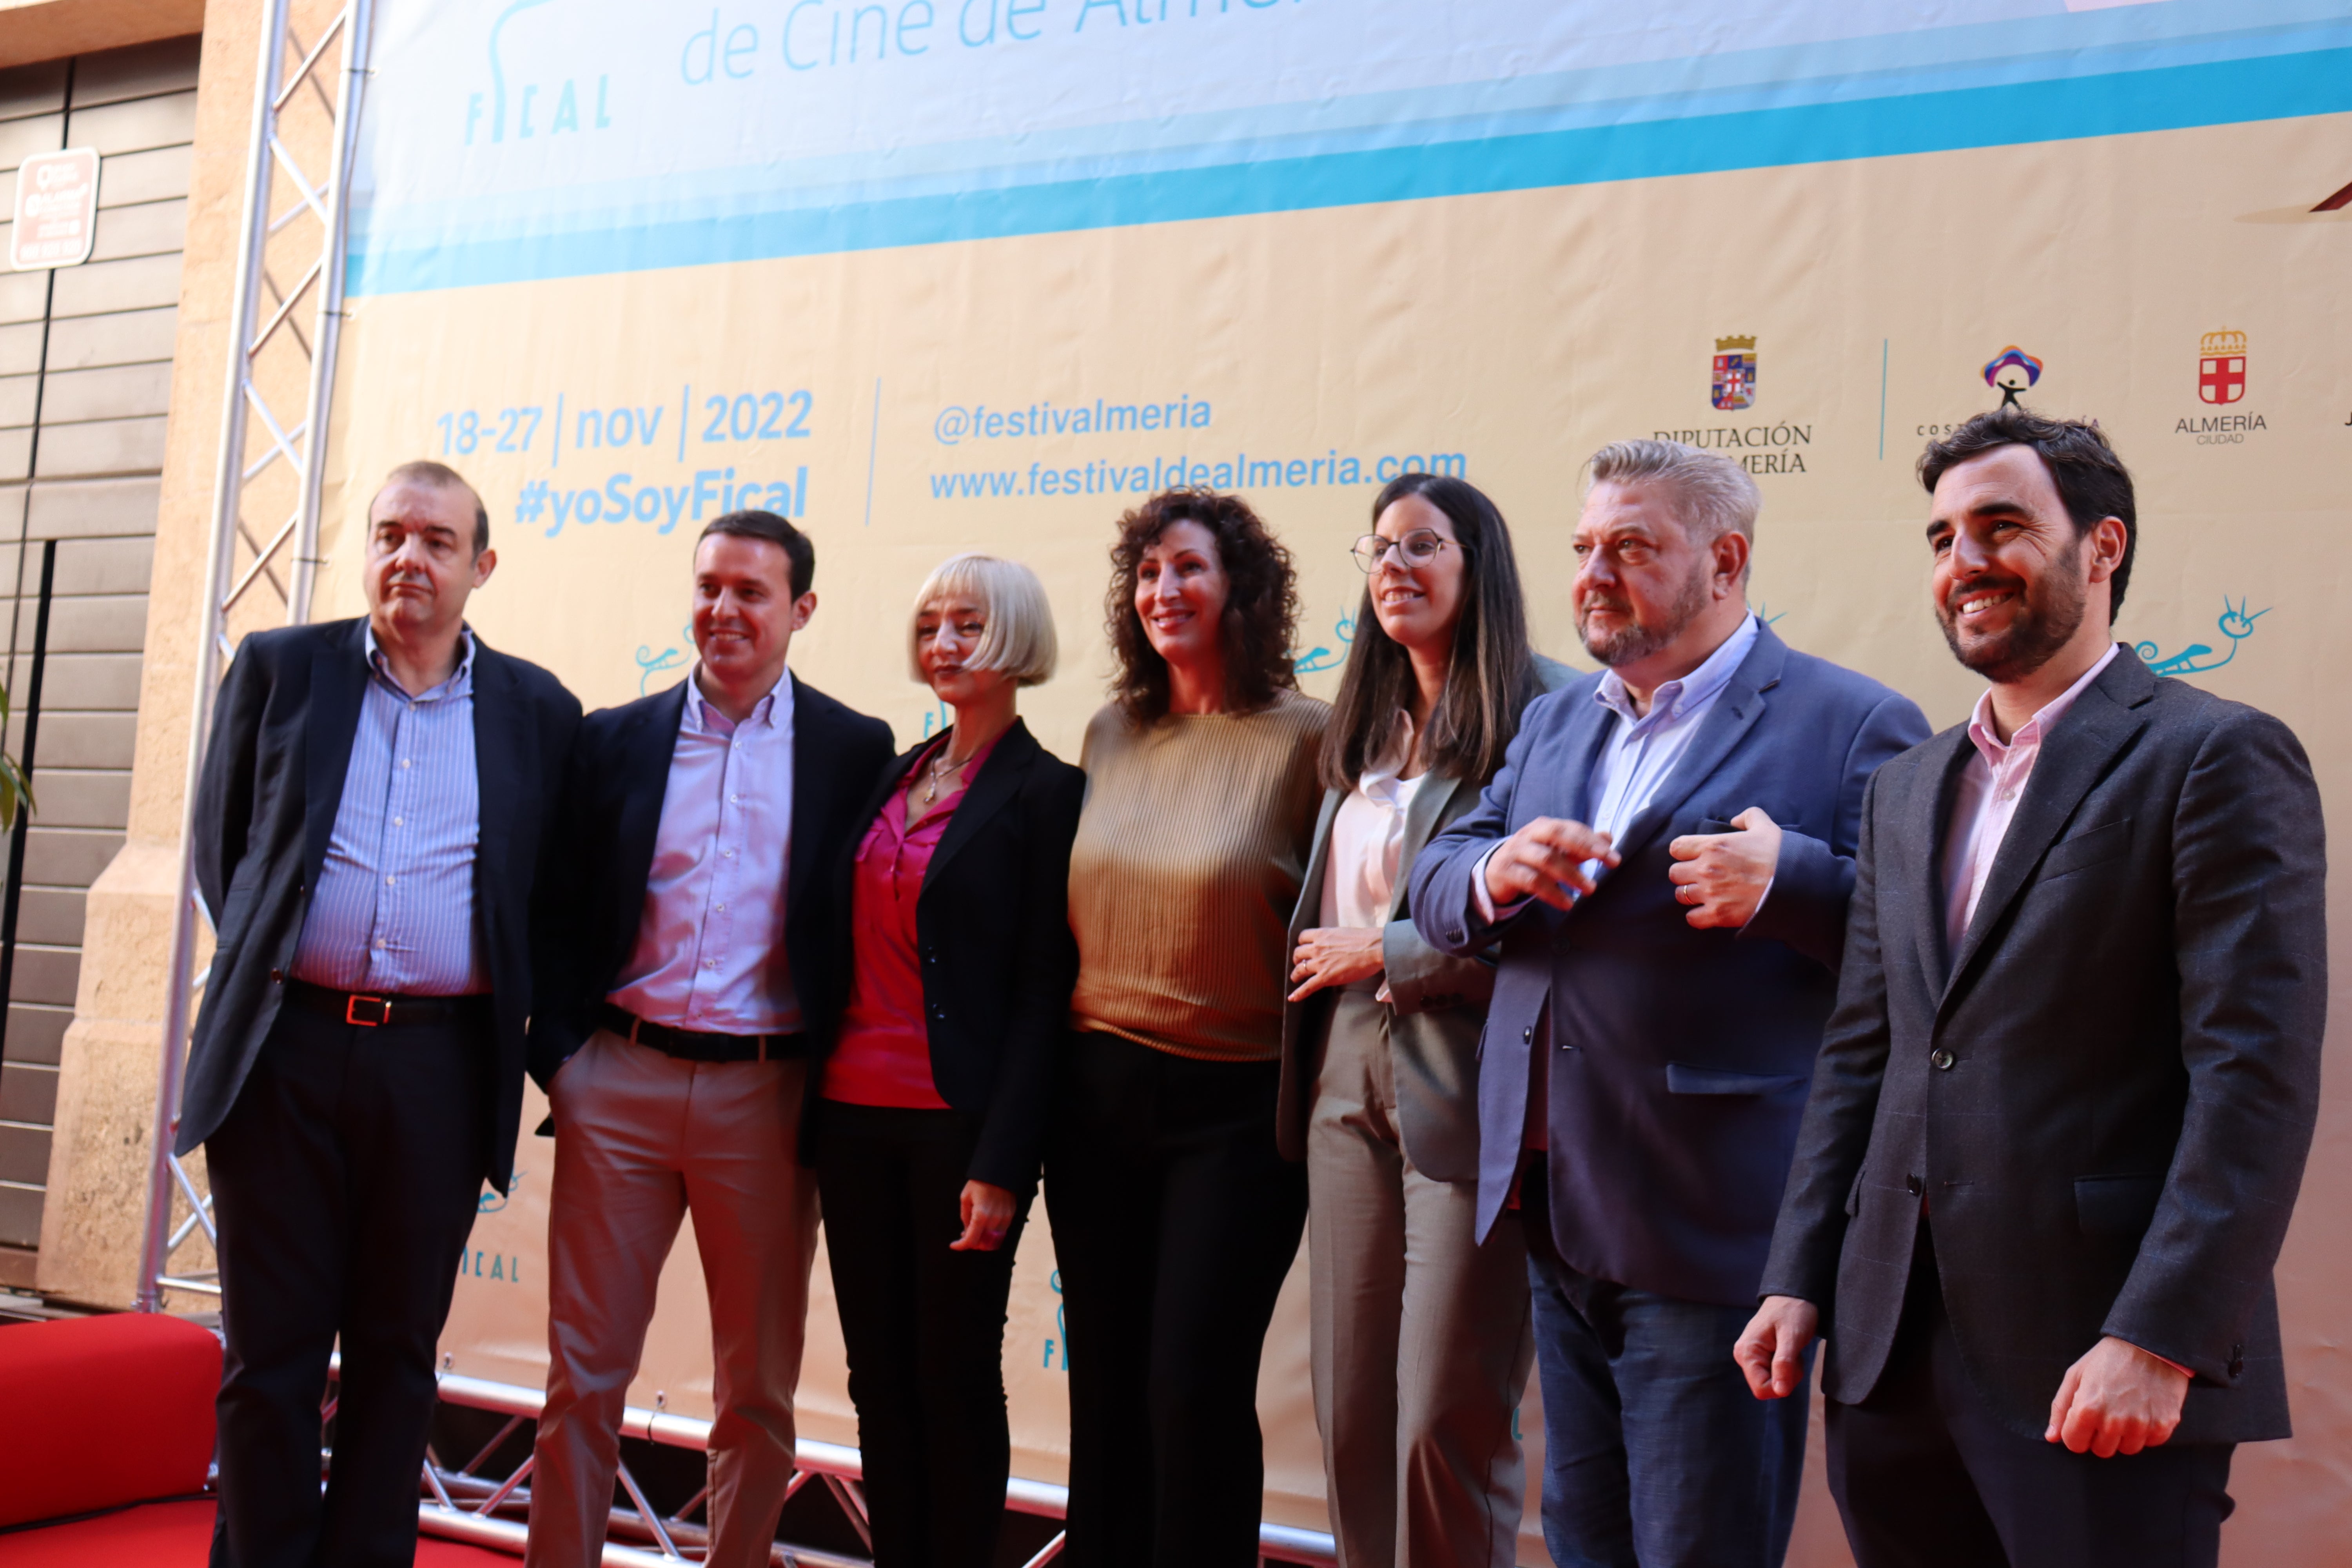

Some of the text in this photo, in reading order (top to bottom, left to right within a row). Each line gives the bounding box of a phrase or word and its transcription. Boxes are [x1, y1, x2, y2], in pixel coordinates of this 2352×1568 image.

[682, 7, 759, 85] de
[783, 0, 934, 71] Cine
[437, 390, 813, 456] 18-27 nov 2022
[935, 394, 1212, 445] @festivalmeria
[2175, 412, 2267, 433] ALMERÍA
[2196, 434, 2244, 445] CIUDAD
[930, 449, 1467, 499] www.festivaldealmeria.com
[515, 466, 808, 538] #yoSoyFical
[462, 1245, 519, 1283] ICAL
